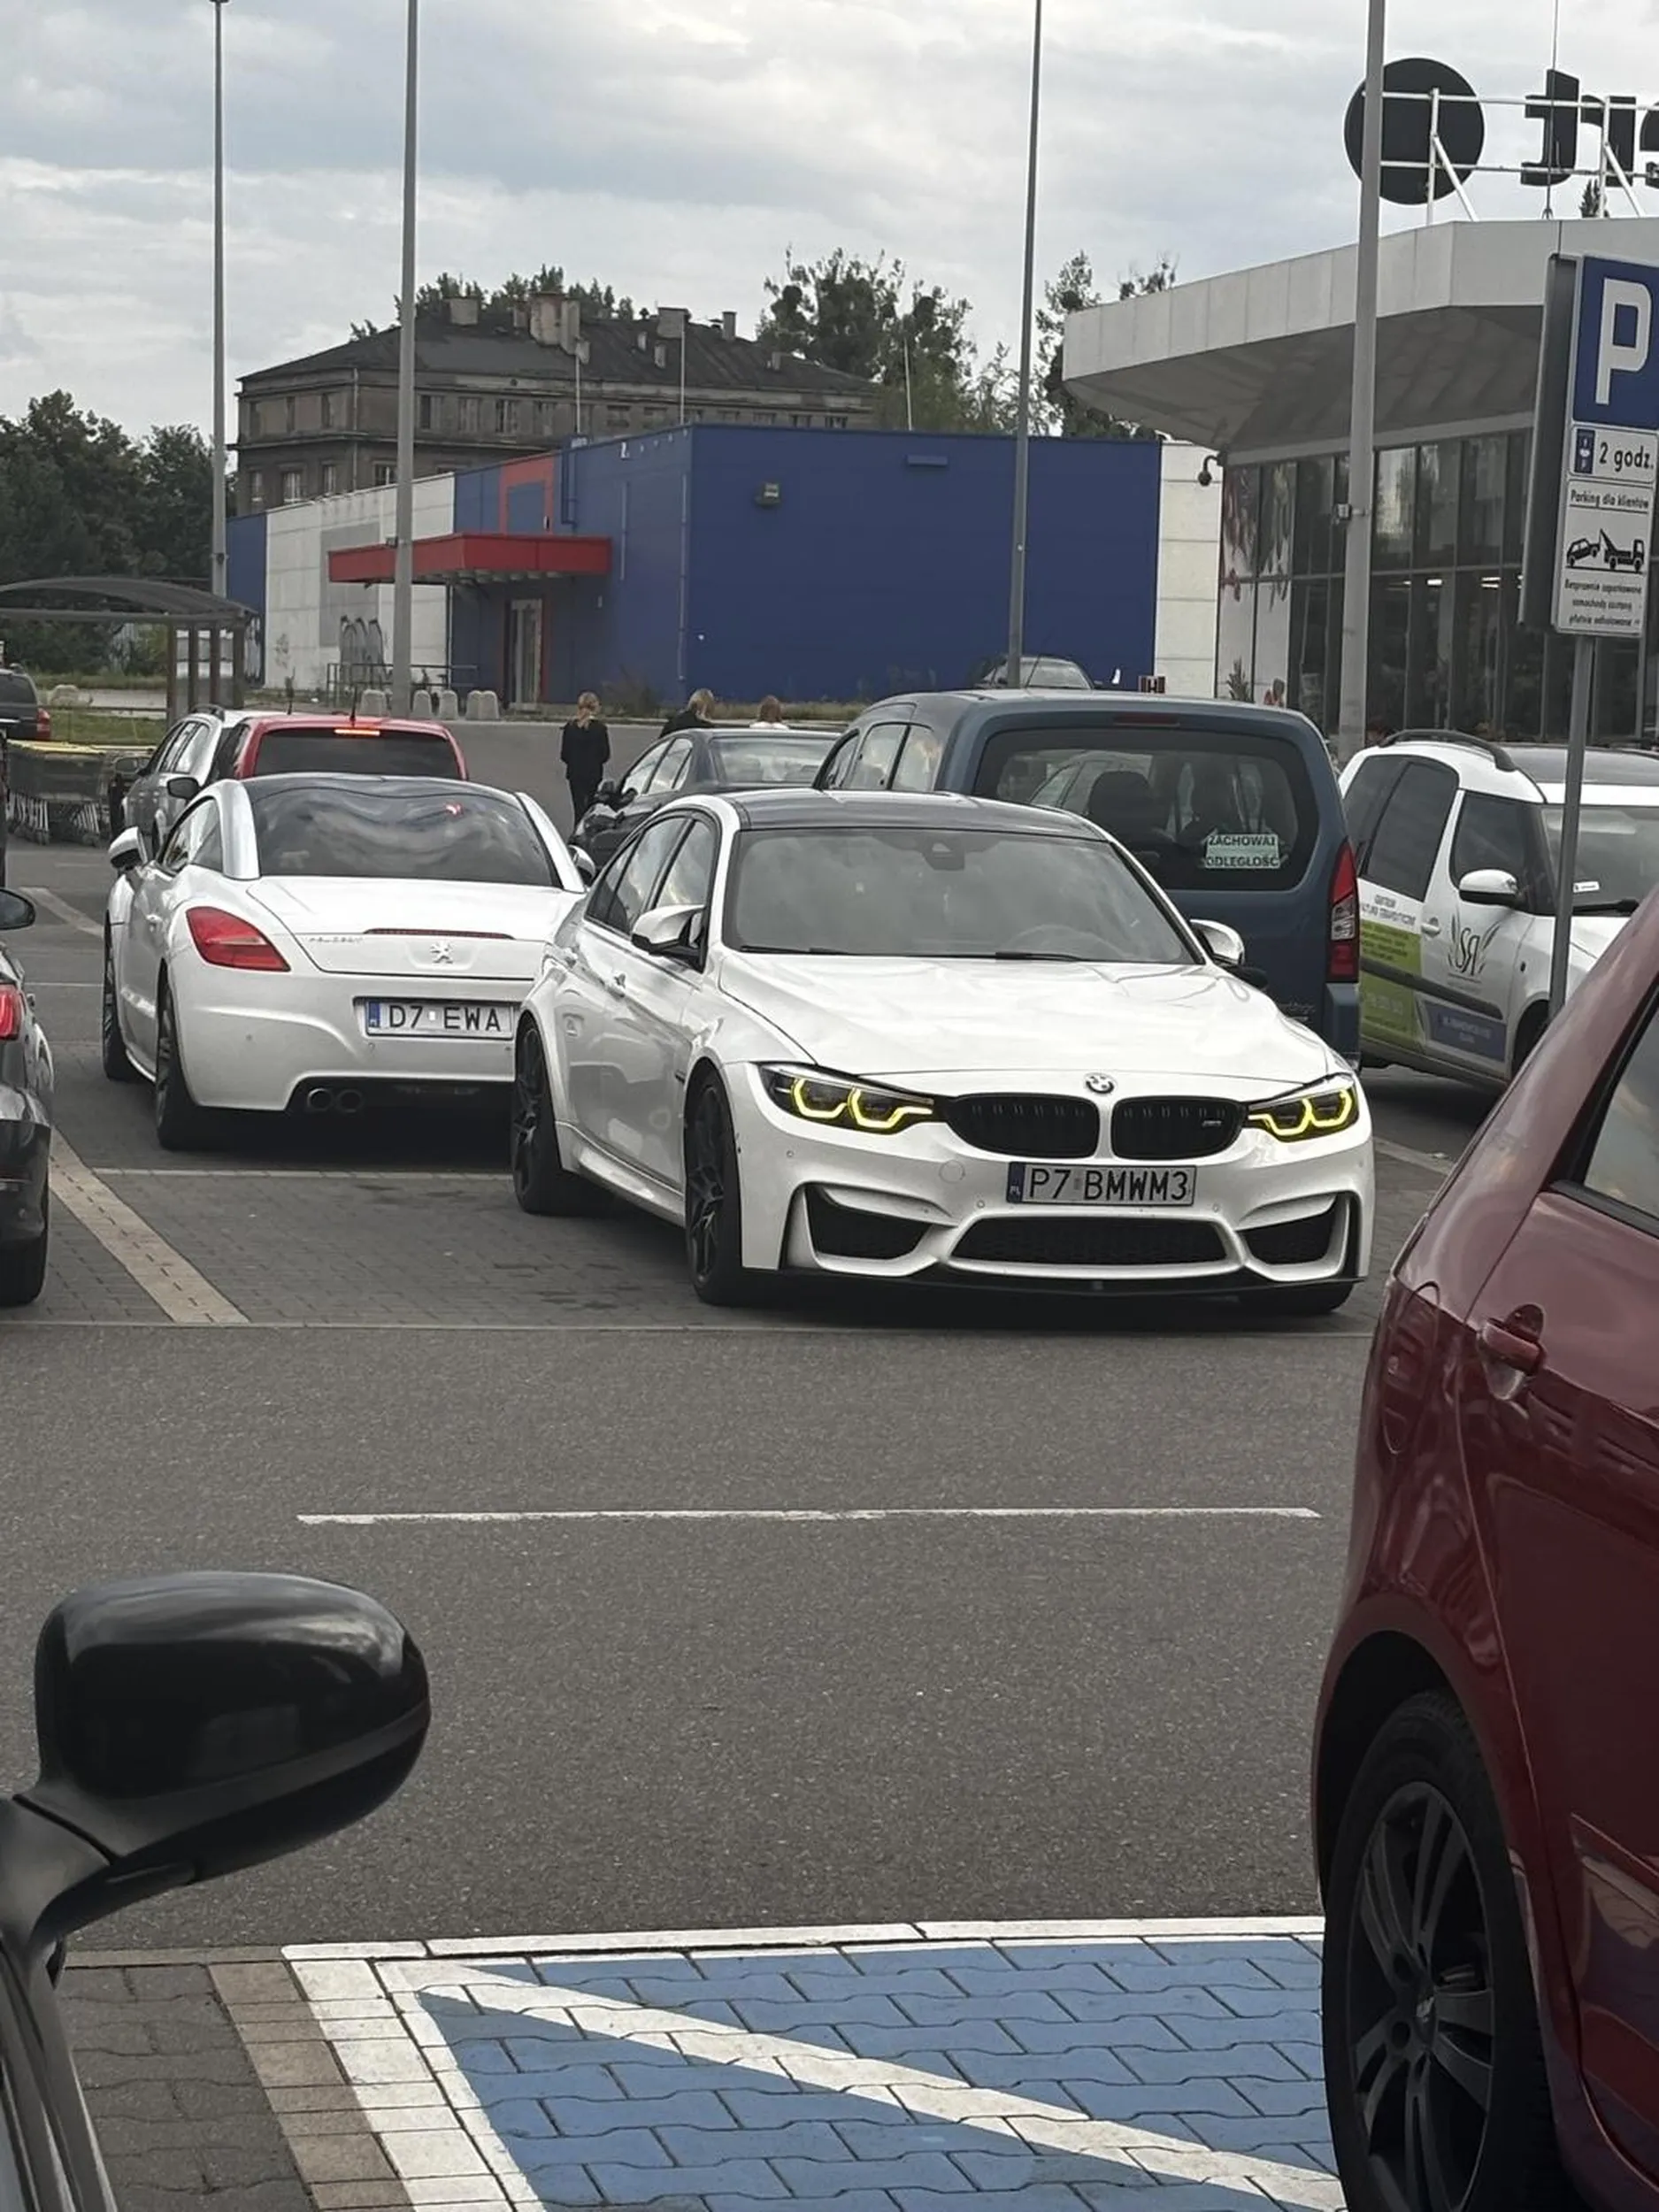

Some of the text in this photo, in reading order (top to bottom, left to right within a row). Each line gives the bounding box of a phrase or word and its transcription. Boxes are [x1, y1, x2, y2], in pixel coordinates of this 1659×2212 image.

[1596, 278, 1652, 405] P
[1599, 442, 1654, 472] 2 godz.
[388, 1005, 502, 1032] D7 EWA
[1029, 1167, 1188, 1202] P7 BMWM3
